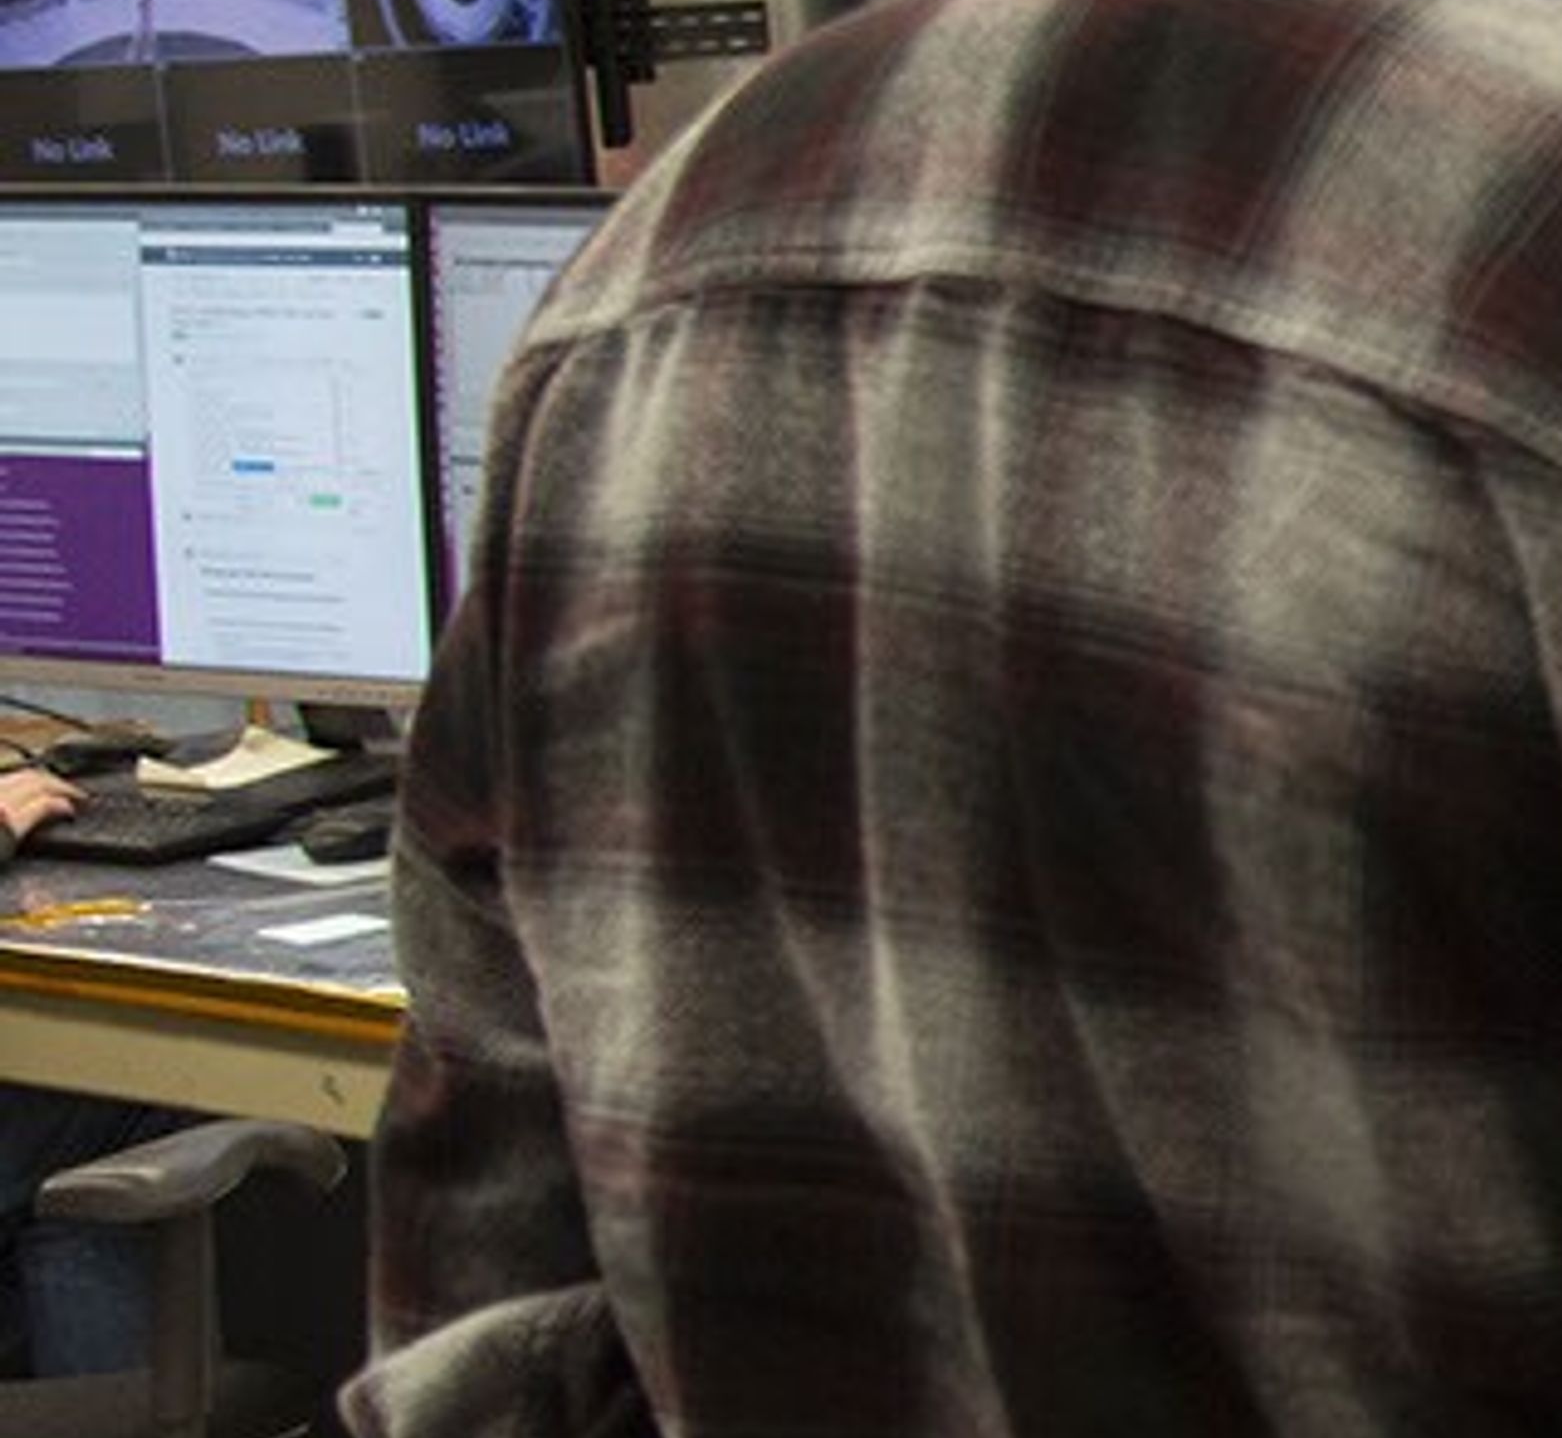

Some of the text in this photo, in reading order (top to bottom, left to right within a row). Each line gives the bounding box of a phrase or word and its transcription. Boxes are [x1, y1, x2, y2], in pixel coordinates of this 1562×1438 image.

[33, 136, 115, 161] No Link
[217, 127, 304, 156] No Link
[418, 120, 509, 149] No Link
